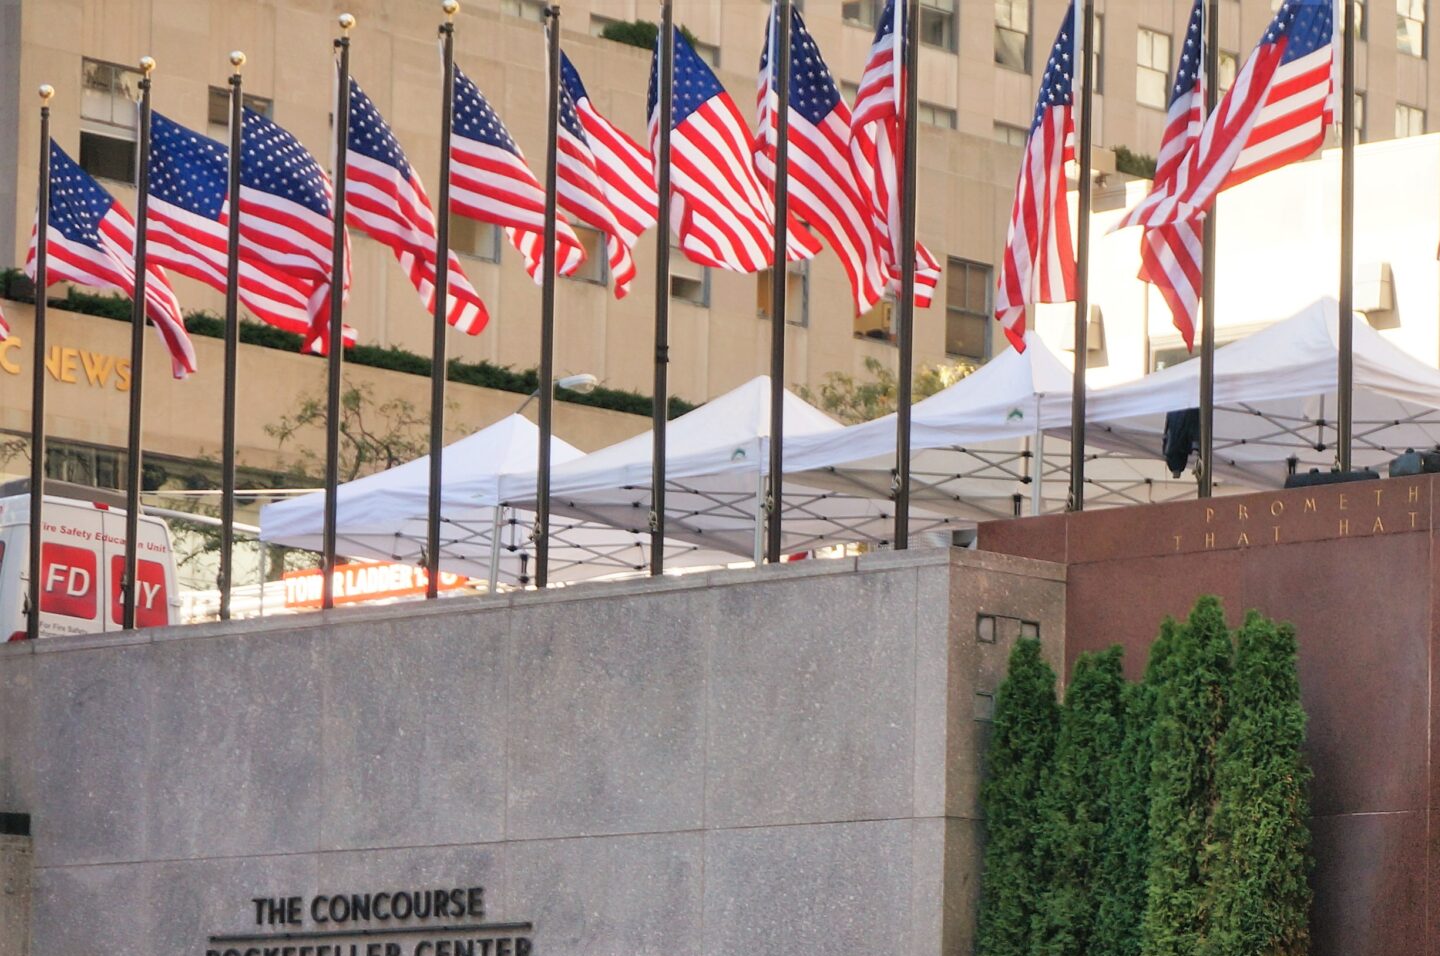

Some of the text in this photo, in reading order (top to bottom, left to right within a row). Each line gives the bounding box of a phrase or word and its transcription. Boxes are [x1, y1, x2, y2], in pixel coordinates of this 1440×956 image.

[45, 345, 130, 391] NEWS
[43, 522, 167, 553] ire Safety Educan Unit
[1173, 526, 1281, 550] THAT
[46, 563, 90, 597] FD
[286, 570, 344, 603] TOWR
[345, 563, 413, 595] LADDER
[252, 887, 485, 925] THE CONCOURSE
